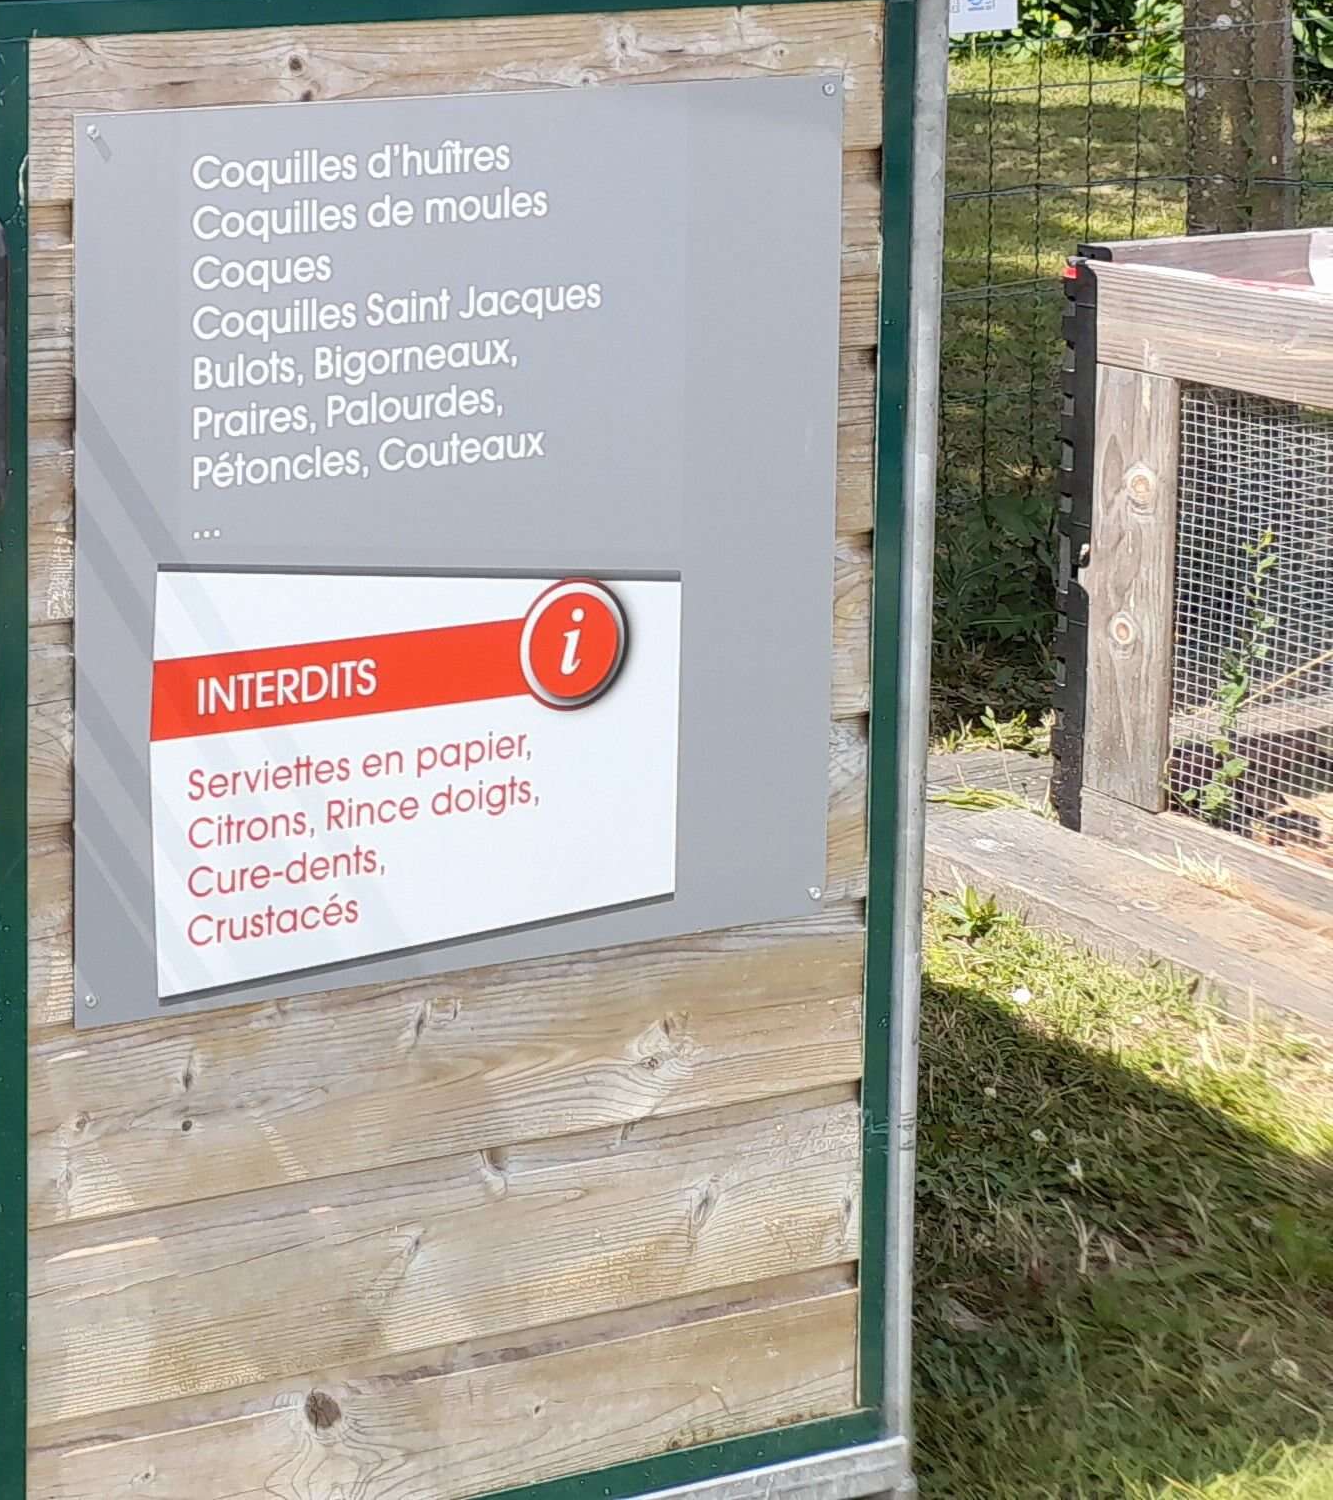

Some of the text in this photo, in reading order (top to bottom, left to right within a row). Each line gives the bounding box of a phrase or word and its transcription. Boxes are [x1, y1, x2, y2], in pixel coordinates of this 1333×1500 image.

[192, 140, 511, 193] Coquilles d'huîtres
[192, 186, 548, 243] Coquilles de moules
[192, 255, 332, 293] Coques
[192, 283, 601, 343] Coquilles Saint Jacques
[193, 338, 518, 390] Bulots, Bigorneaux,
[193, 384, 503, 440] Praires, Palourdes,
[193, 431, 544, 490] Pétoncles, Couteaux
[198, 658, 377, 715] INTERDITS
[187, 731, 531, 802] Serviettes en papier,
[186, 775, 540, 851] Citrons, Rince doigts,
[186, 845, 386, 900] Cure-dents,
[186, 893, 359, 948] Crustacés
